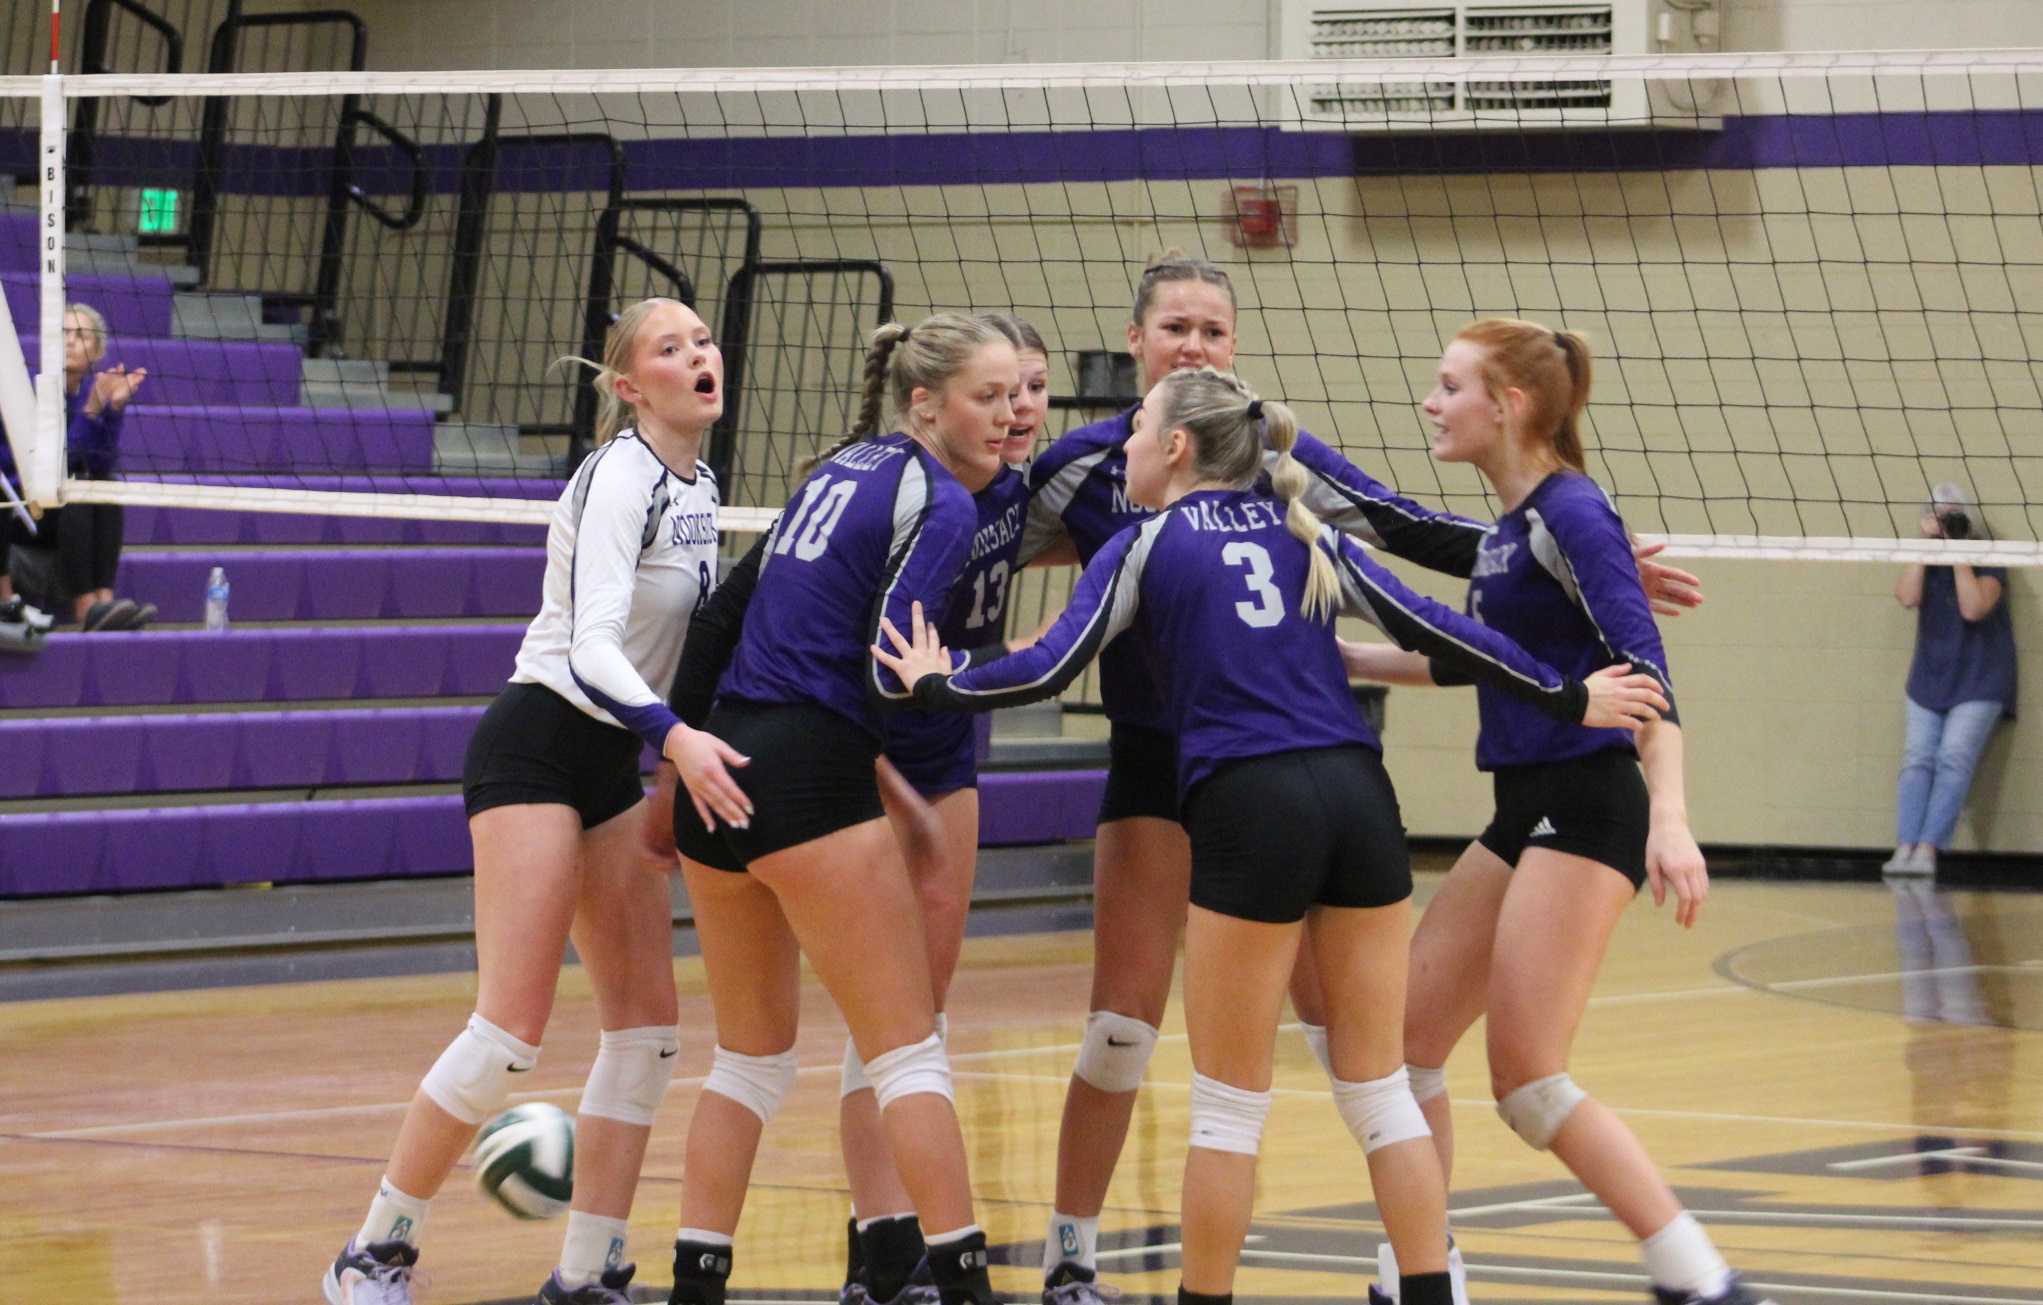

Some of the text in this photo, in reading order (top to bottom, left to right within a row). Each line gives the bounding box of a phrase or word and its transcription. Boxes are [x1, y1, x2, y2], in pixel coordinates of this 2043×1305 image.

[46, 166, 56, 274] BISON
[774, 473, 858, 562] 10
[1180, 500, 1282, 532] VALLEY
[965, 559, 1010, 629] 13
[1221, 541, 1286, 628] 3
